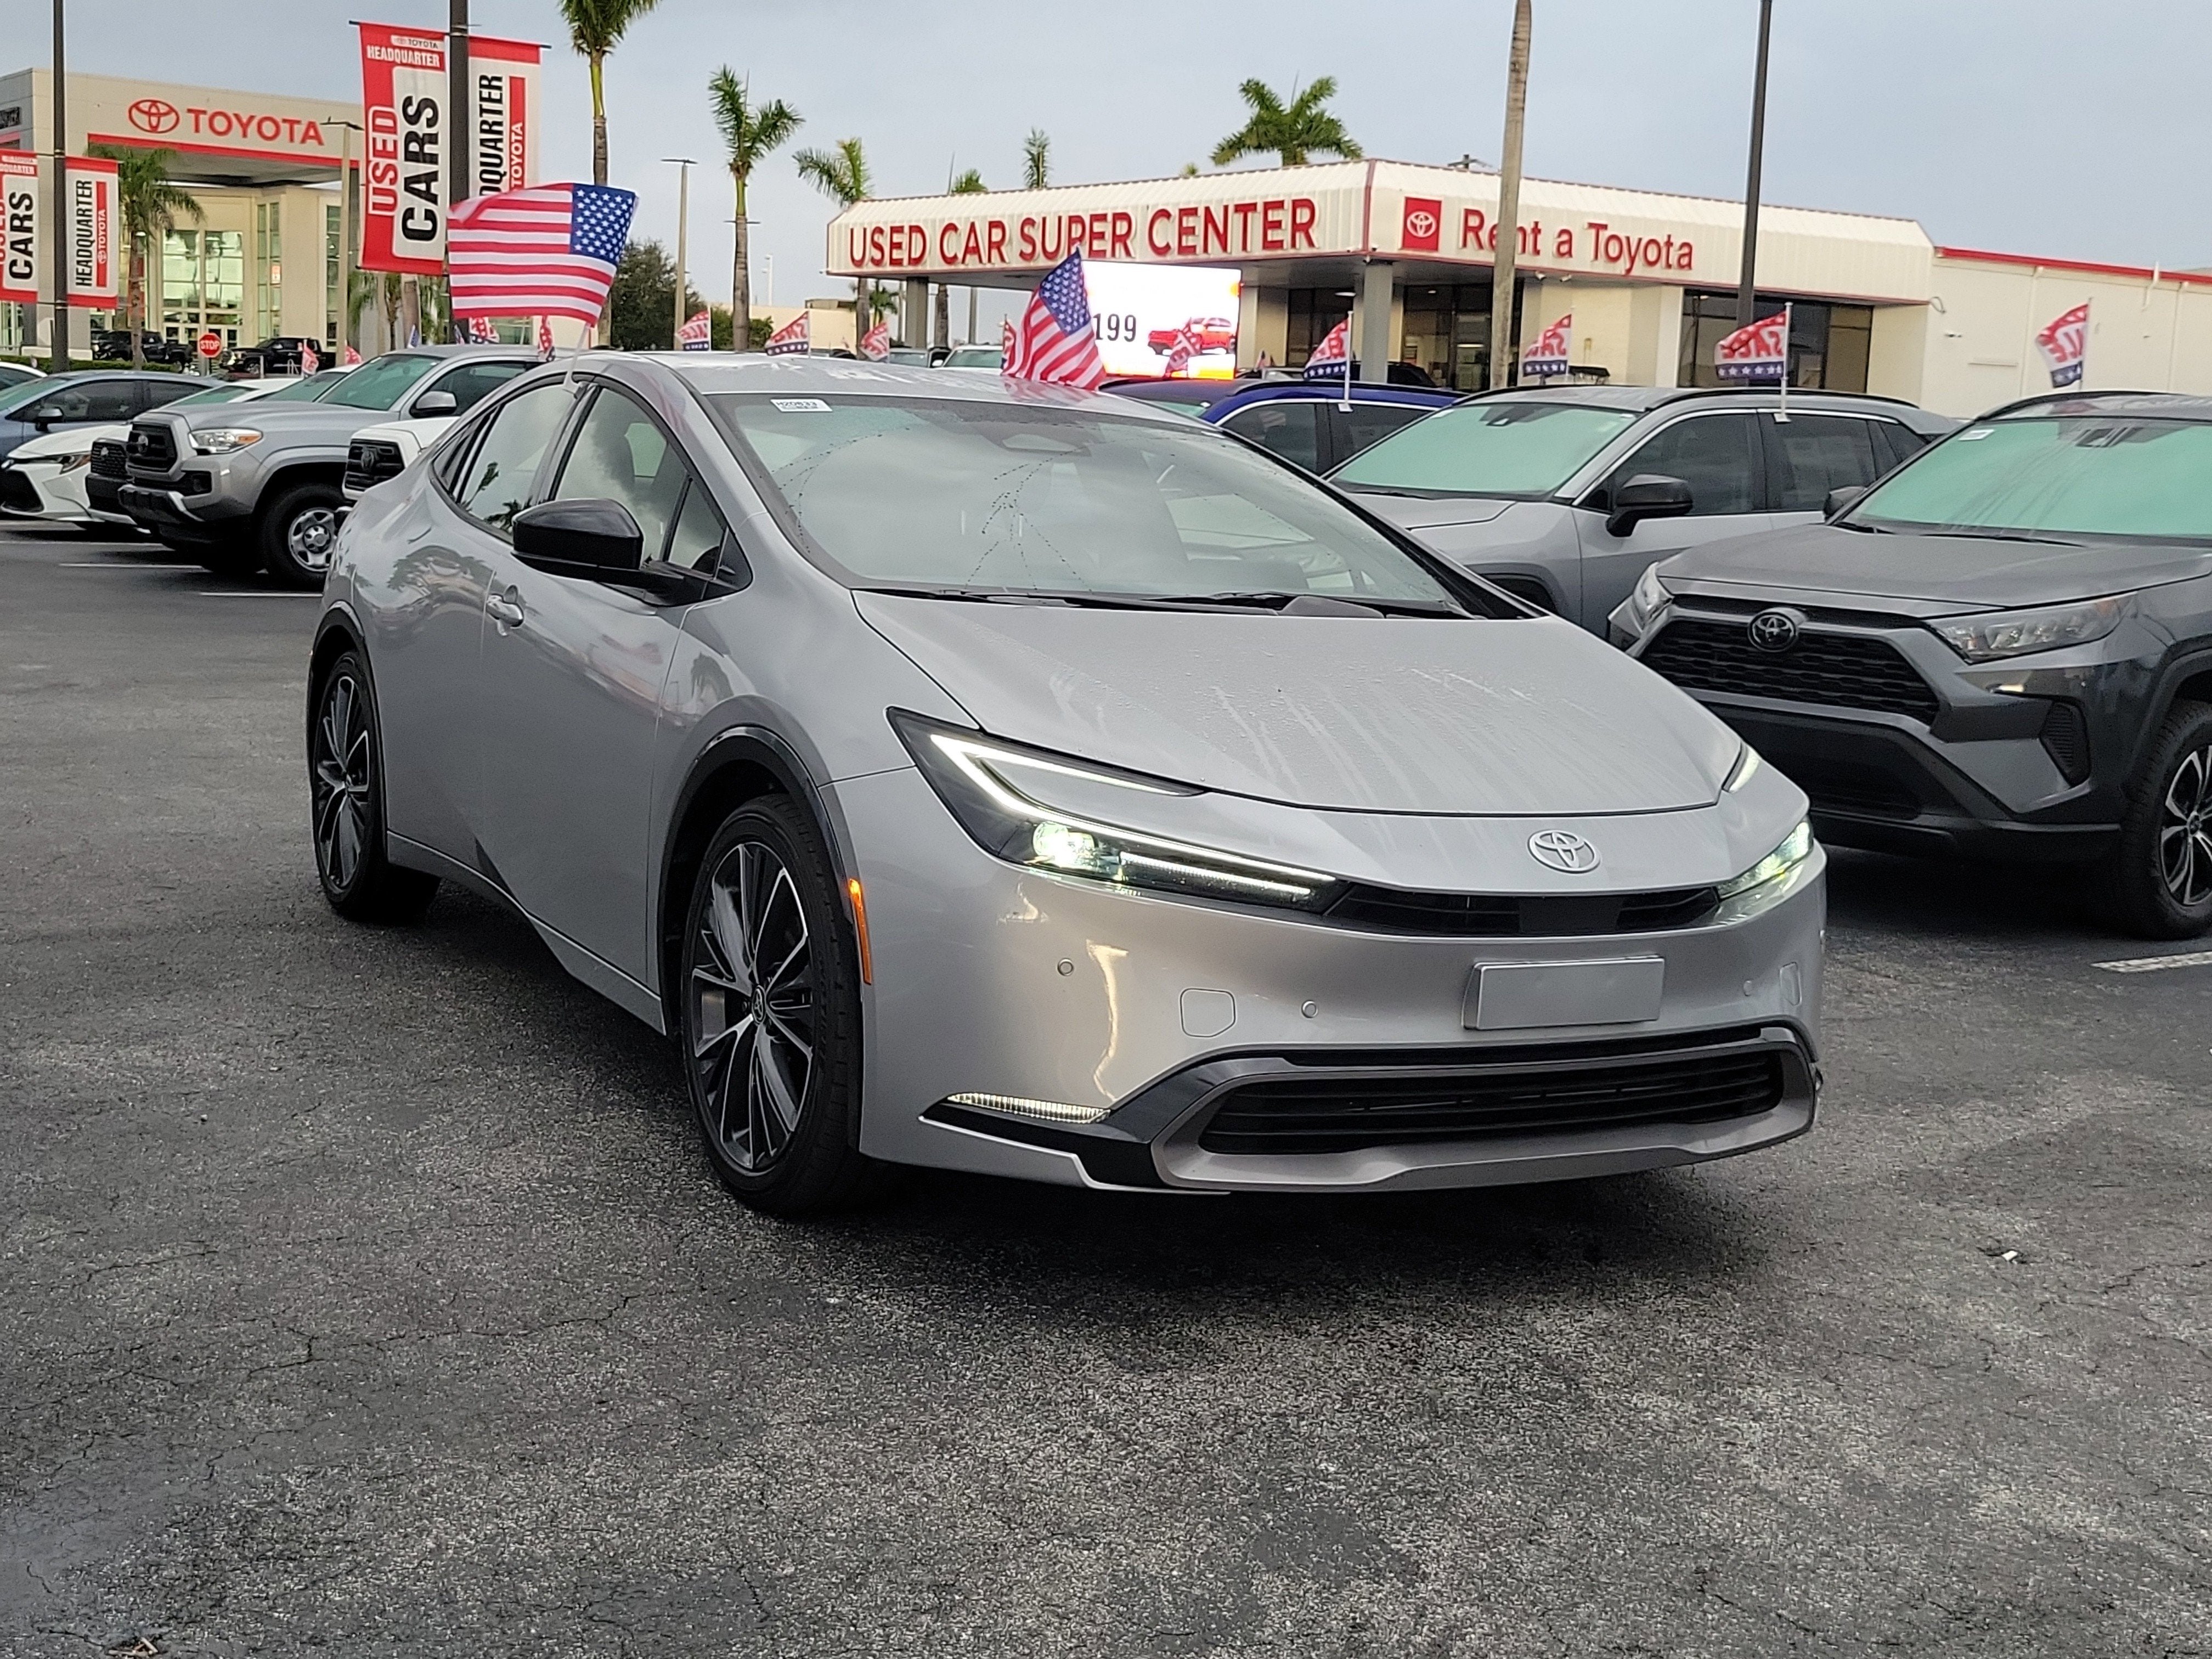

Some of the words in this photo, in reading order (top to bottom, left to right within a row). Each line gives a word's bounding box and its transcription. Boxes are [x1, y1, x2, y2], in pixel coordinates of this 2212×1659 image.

[366, 44, 441, 67] HEADQUARTER
[408, 38, 438, 48] TOYOTA
[187, 108, 325, 146] TOYOTA
[479, 75, 507, 196] DQUARTER
[511, 122, 523, 188] TOYOTA
[370, 109, 398, 213] USED
[402, 95, 439, 242] CARS
[9, 192, 33, 280] CARS
[76, 180, 95, 286] HEADQUARTER
[98, 209, 106, 251] TOYOTA
[850, 225, 927, 267] USED
[940, 221, 1007, 266] CAR
[1019, 212, 1134, 261] SUPER
[1148, 198, 1316, 257] CENTER
[1556, 228, 1573, 258] a
[1587, 222, 1693, 276] Toyota
[200, 340, 220, 350] STOP
